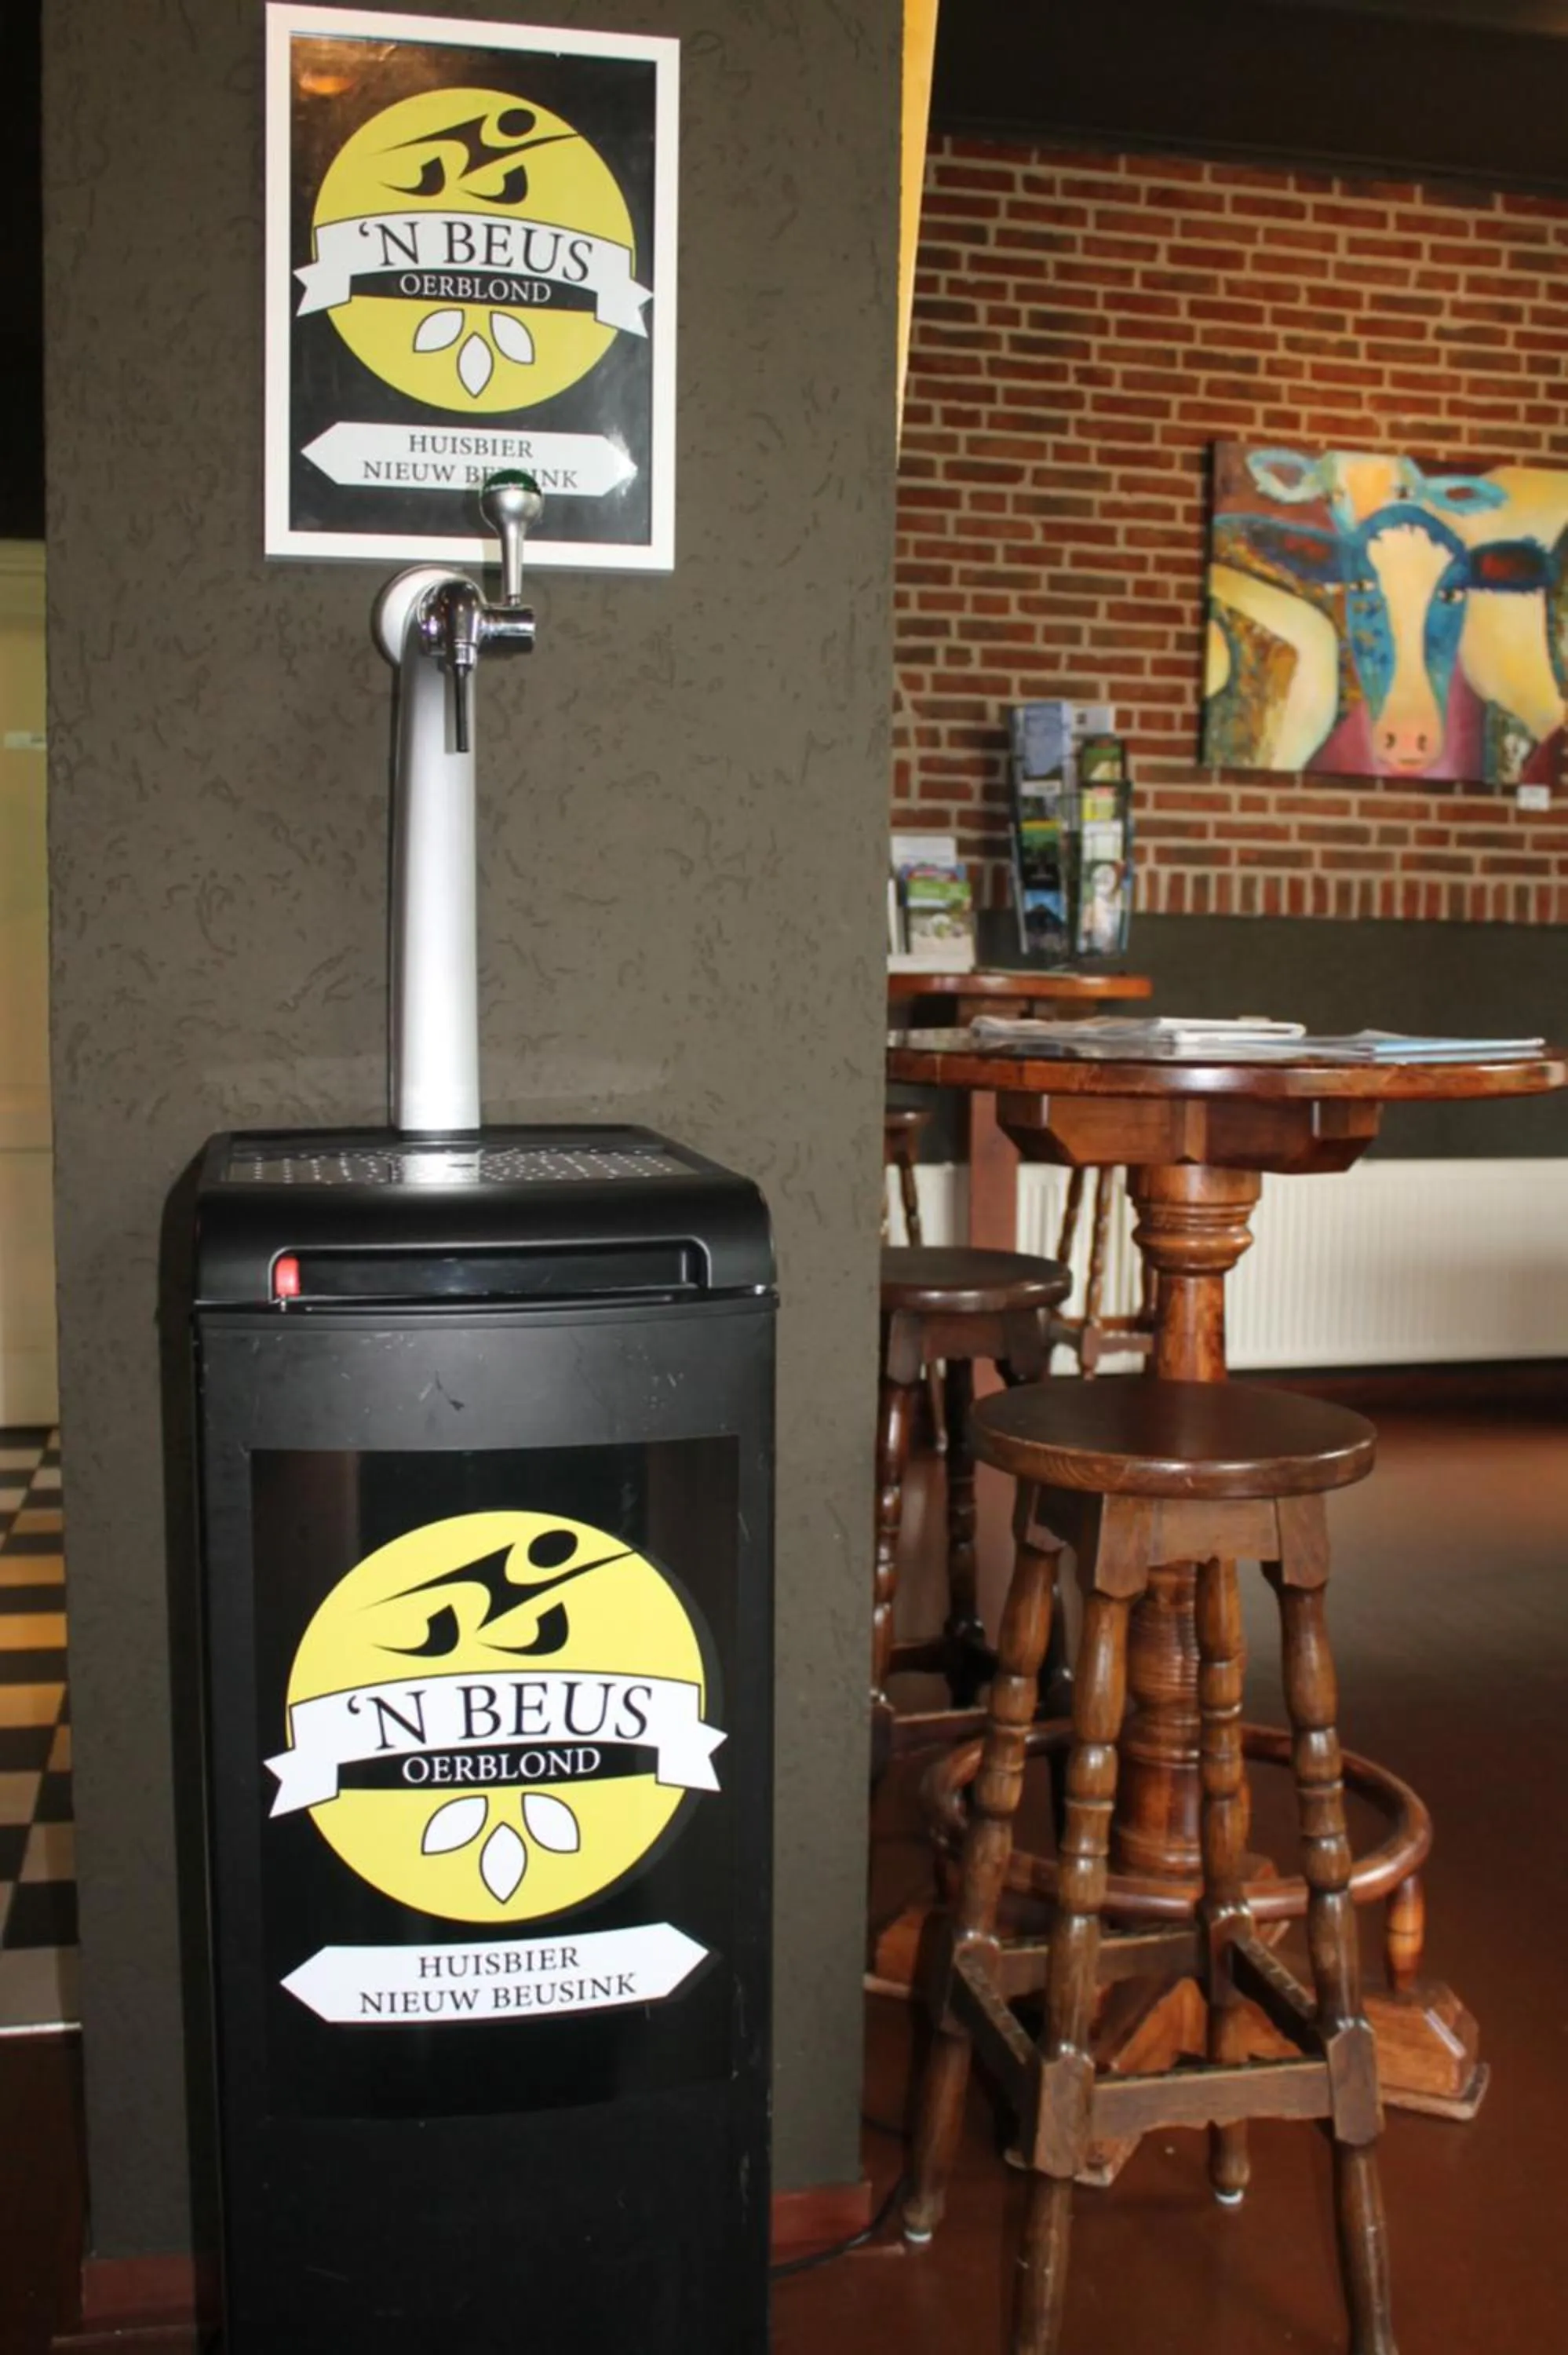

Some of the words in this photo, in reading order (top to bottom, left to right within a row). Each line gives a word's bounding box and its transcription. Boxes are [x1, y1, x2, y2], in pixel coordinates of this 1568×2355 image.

[443, 221, 593, 281] BEUS
[399, 272, 551, 303] OERBLOND
[408, 433, 534, 458] HUISBIER
[363, 459, 457, 484] NIEUW
[457, 1681, 652, 1740] BEUS
[401, 1747, 602, 1784] OERBLOND
[418, 1946, 580, 1979] HUISBIER
[359, 1990, 481, 2015] NIEUW
[492, 1973, 637, 2011] BEUSINK
